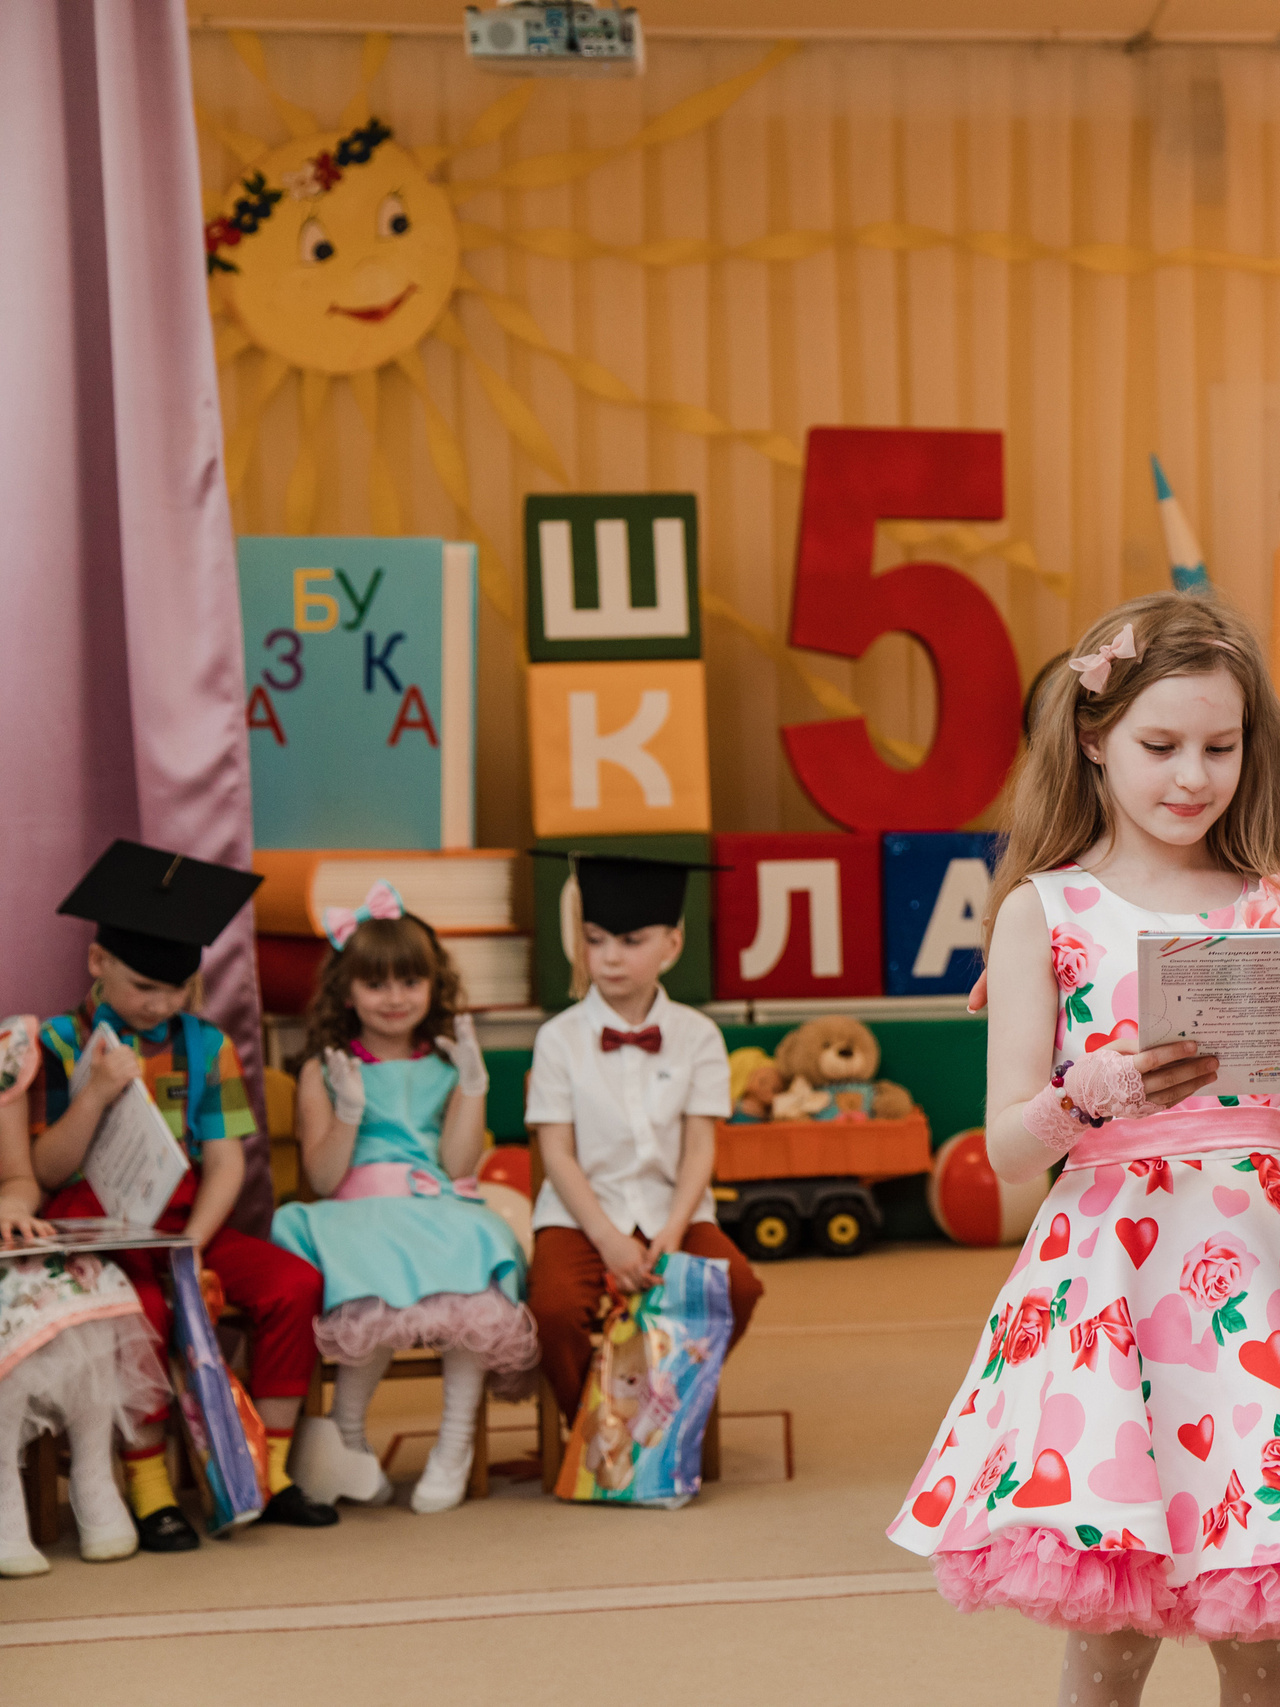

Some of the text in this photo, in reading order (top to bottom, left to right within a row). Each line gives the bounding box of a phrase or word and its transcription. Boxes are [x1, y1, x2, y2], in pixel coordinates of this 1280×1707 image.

[539, 517, 690, 640] Ш
[782, 427, 1023, 834] 5
[568, 689, 674, 810] К
[739, 858, 843, 981] Л
[1191, 1020, 1199, 1028] 3
[1195, 1009, 1203, 1017] 2
